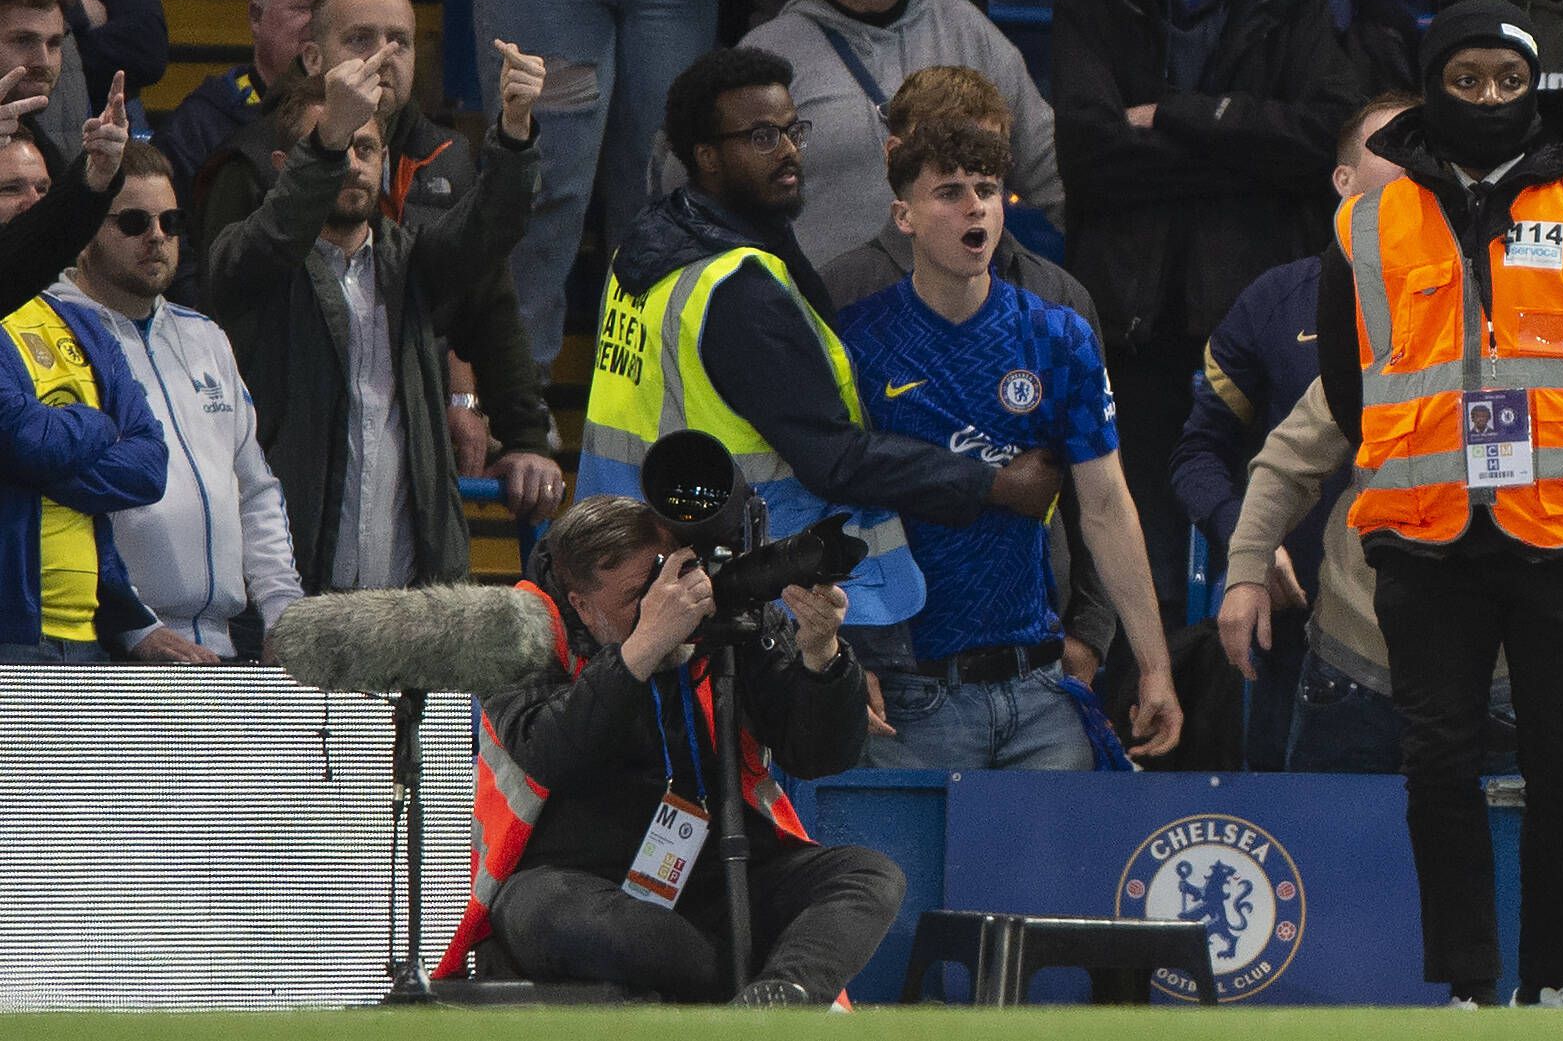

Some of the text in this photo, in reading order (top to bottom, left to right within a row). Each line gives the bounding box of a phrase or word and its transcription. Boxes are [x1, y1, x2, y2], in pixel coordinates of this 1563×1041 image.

[656, 804, 679, 830] M
[1150, 821, 1271, 864] CHELSEA
[1156, 961, 1272, 993] OOTBL CLUB
